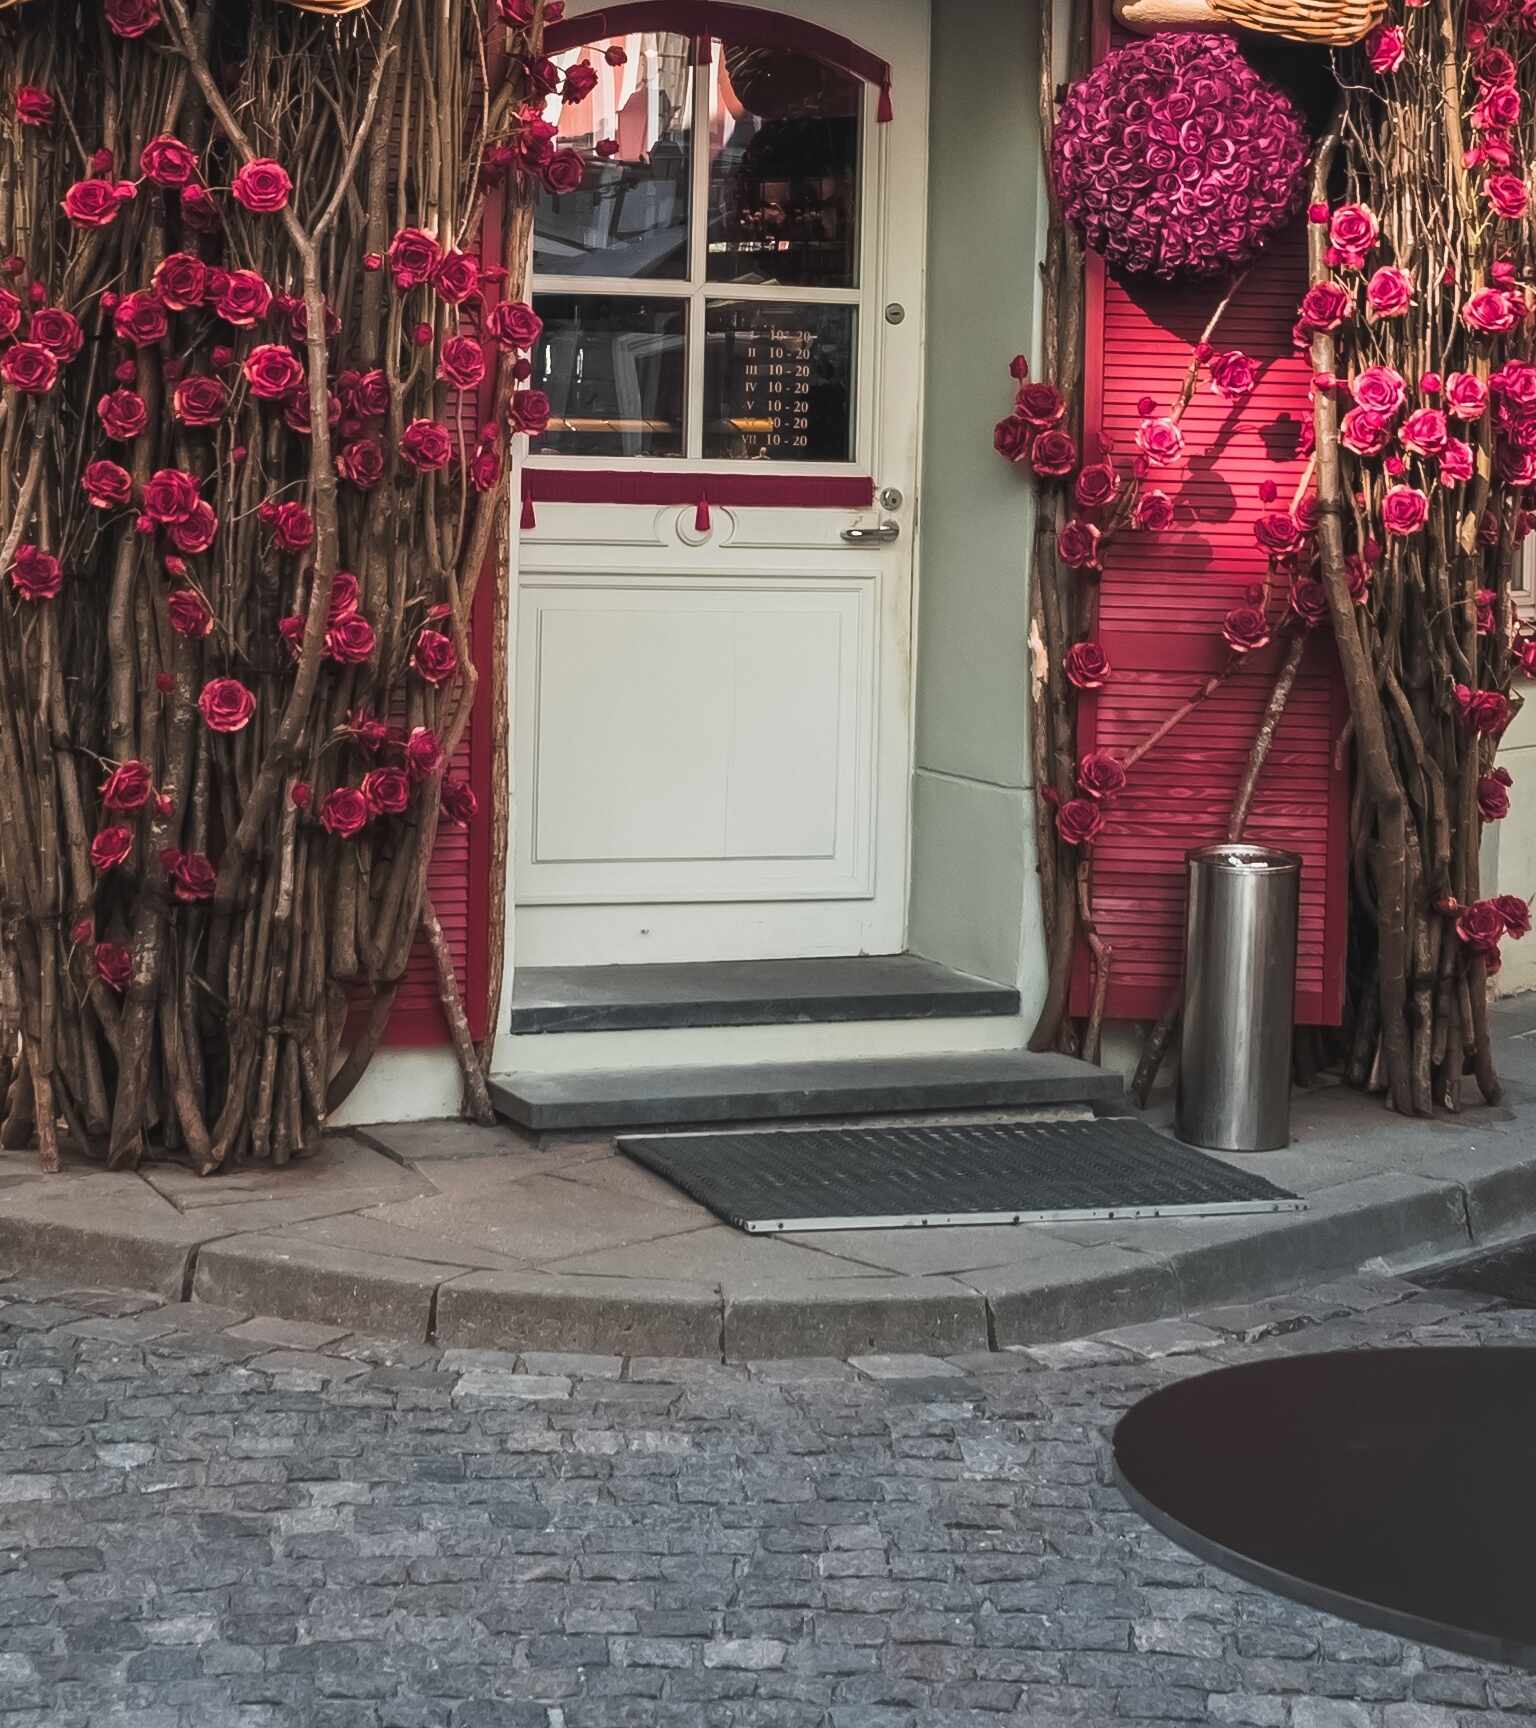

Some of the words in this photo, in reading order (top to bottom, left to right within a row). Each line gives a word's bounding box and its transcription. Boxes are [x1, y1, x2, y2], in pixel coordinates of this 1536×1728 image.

[748, 347, 756, 358] II
[769, 346, 783, 359] 10
[795, 348, 810, 360] 20
[745, 364, 758, 375] III
[769, 364, 783, 376] 10
[795, 365, 810, 377] 20
[745, 381, 757, 392] IV
[768, 381, 782, 393] 10
[794, 382, 809, 394] 20
[746, 400, 754, 410] V
[768, 399, 782, 411] 10
[793, 400, 809, 413] 20
[792, 417, 808, 429] 20
[767, 434, 781, 445] 10
[792, 435, 808, 446] 20
